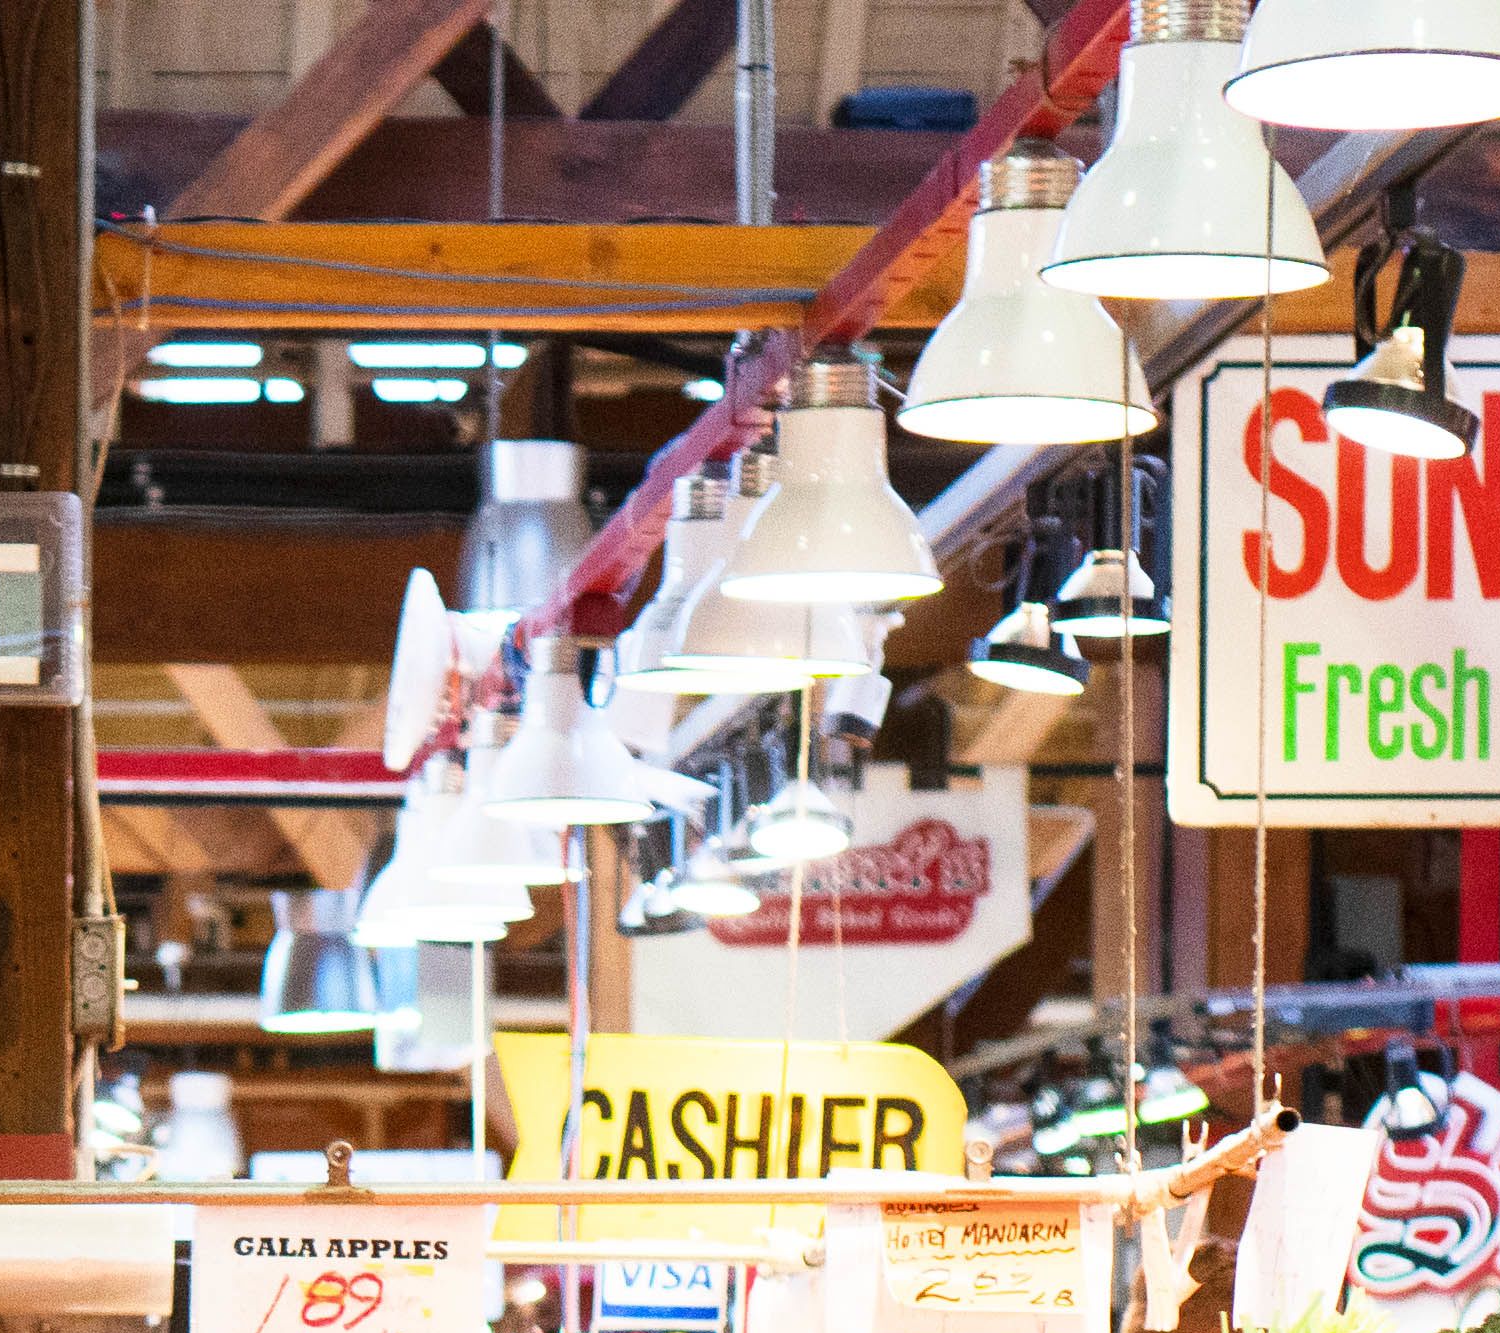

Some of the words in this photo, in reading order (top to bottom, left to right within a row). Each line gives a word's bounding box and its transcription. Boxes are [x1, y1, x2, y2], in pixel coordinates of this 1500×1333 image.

[1282, 642, 1490, 763] Fresh
[562, 1090, 926, 1180] CASHIER
[960, 1218, 1069, 1245] MANDARIN
[233, 1236, 317, 1258] GALA
[325, 1238, 449, 1260] APPLES
[620, 1264, 713, 1290] VISA
